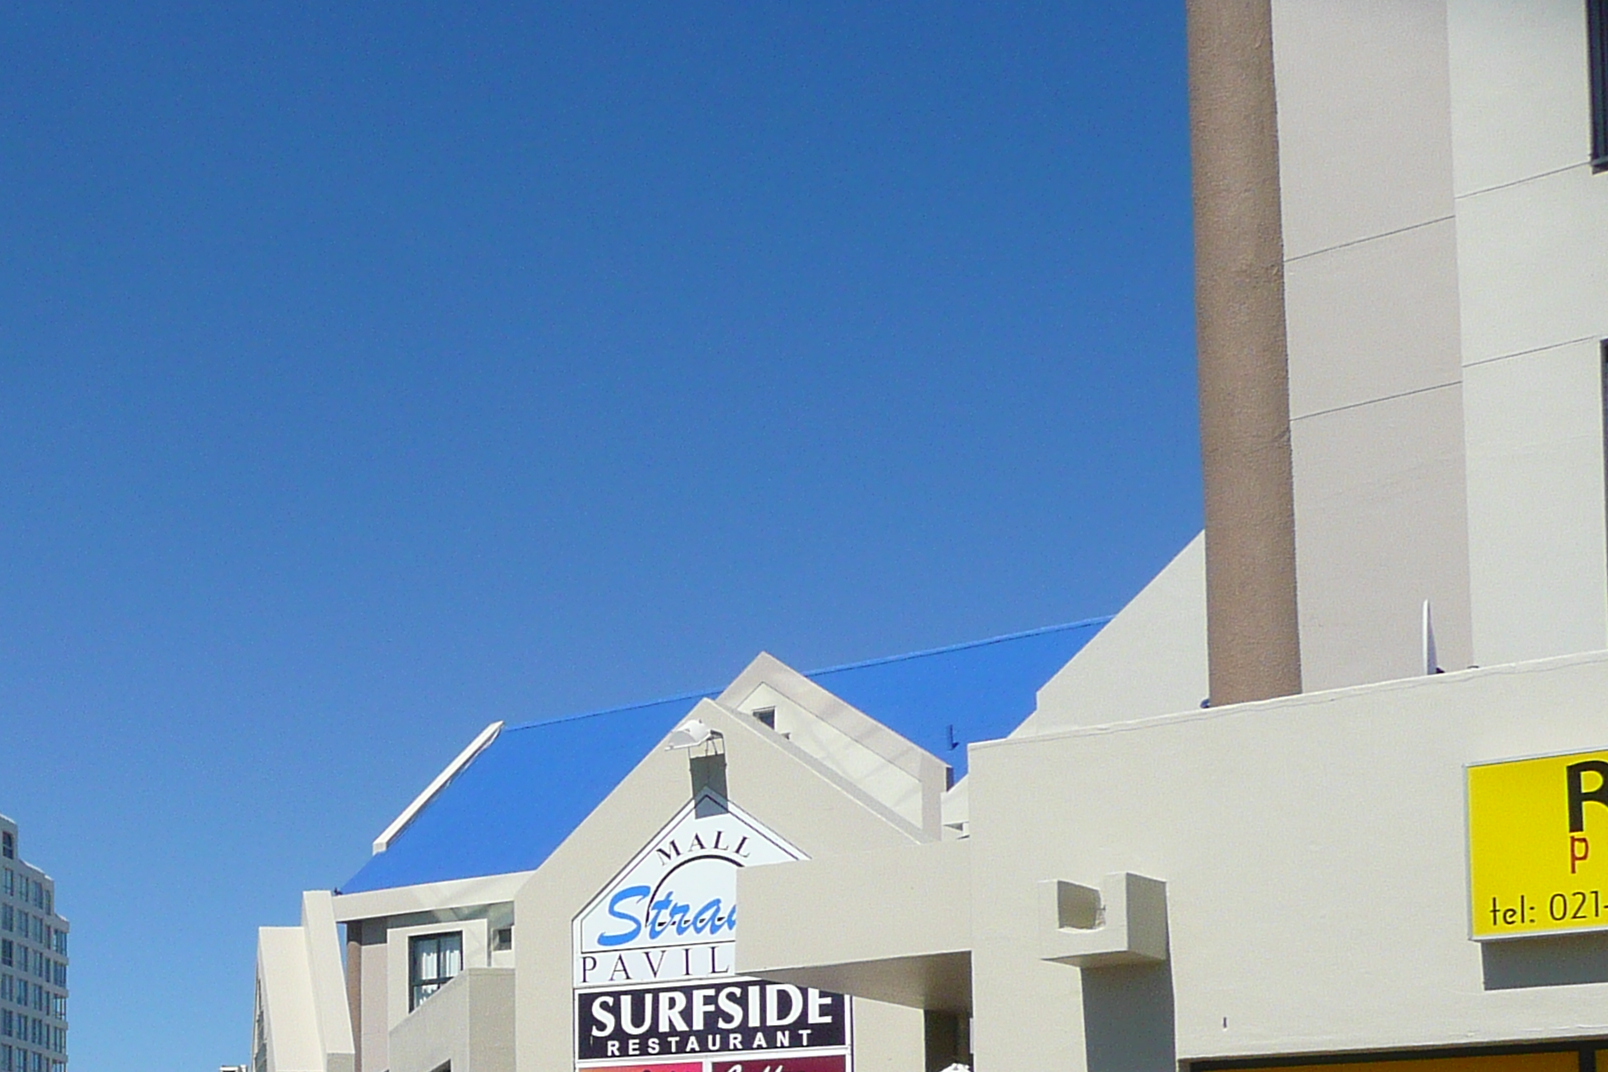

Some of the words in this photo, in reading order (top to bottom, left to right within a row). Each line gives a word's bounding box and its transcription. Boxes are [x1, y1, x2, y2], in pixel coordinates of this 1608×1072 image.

[656, 830, 751, 866] MALL
[1490, 894, 1535, 927] tel:
[591, 983, 832, 1038] SURFSIDE
[606, 1029, 812, 1057] RESTAURANT
